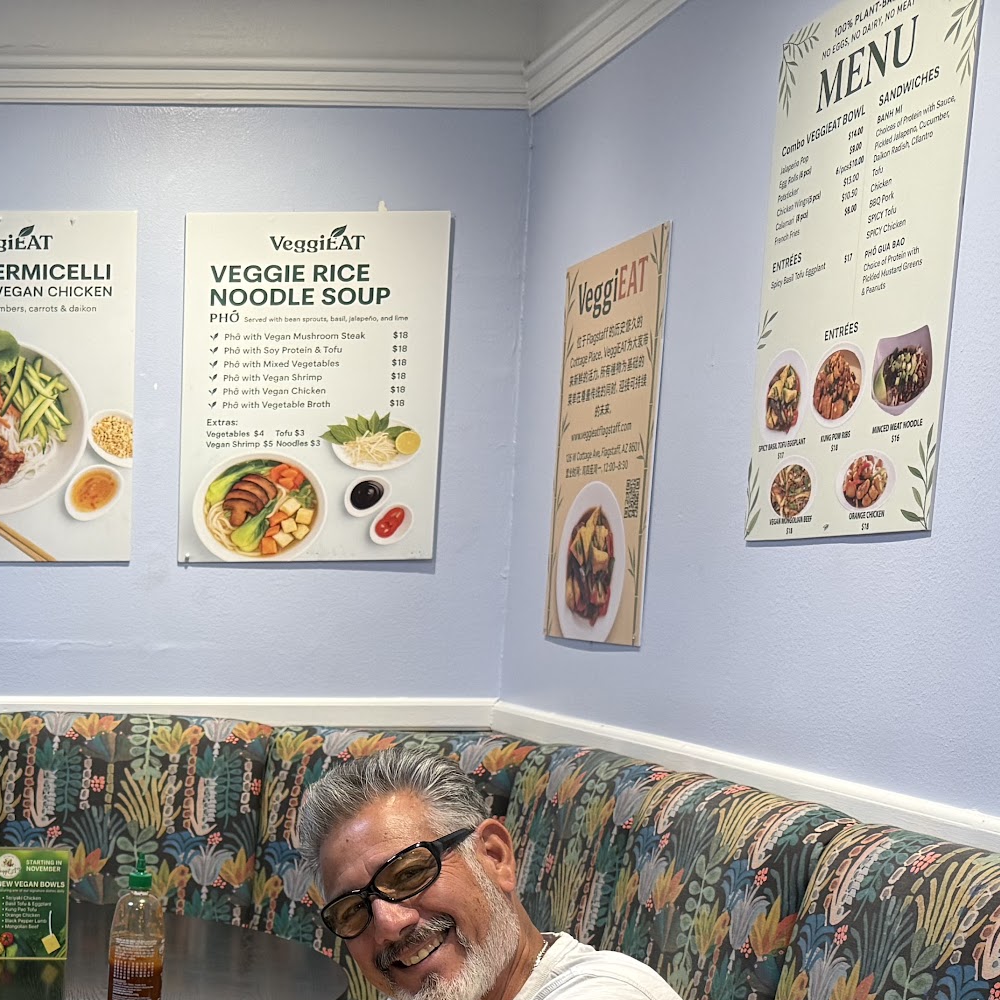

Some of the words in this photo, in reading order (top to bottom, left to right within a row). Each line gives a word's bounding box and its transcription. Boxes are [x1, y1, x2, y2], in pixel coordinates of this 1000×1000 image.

[822, 48, 831, 60] NO
[833, 38, 849, 53] EGGS,
[851, 30, 860, 42] NO
[863, 16, 883, 36] DAIRY,
[885, 9, 895, 22] NO
[834, 16, 853, 38] 100%
[816, 14, 920, 114] MENU
[878, 66, 940, 106] SANDWICHES
[876, 123, 896, 137] Choices
[897, 116, 903, 127] of
[903, 110, 921, 124] Protein
[923, 103, 935, 114] with
[936, 95, 956, 109] Sauce,
[877, 110, 895, 124] BANH
[895, 105, 903, 115] MI
[782, 139, 805, 157] Combo
[807, 117, 841, 144] VEGGIEAT
[843, 105, 865, 125] BOWL
[875, 137, 892, 150] Pickled
[870, 178, 892, 193] Chicken
[869, 197, 881, 209] BBQ
[881, 191, 895, 203] Pork
[866, 226, 882, 239] SPICY
[883, 219, 906, 233] Chicken
[270, 234, 365, 253] VeggiEAT
[210, 265, 305, 283] VEGGIE
[313, 264, 370, 282] RICE
[48, 286, 112, 297] CHICKEN
[211, 288, 315, 306] NOODLE
[321, 287, 390, 305] SOUP
[578, 255, 649, 319] VeggiEAT
[28, 305, 58, 313] carrots
[60, 304, 67, 312] &
[243, 333, 262, 341] with
[264, 333, 291, 342] Vegan
[293, 332, 339, 340] Mushroom
[341, 331, 365, 340] Steak
[393, 331, 408, 339] $18
[824, 322, 859, 341] ENTRÉES
[243, 346, 261, 354] with
[264, 346, 280, 355] Soy
[282, 346, 312, 354] Protein
[314, 346, 321, 354] &
[323, 345, 342, 354] Tofu
[392, 345, 408, 353] $18
[207, 418, 238, 426] Extras:
[206, 430, 250, 439] Vegetables
[254, 430, 264, 438] $4
[275, 429, 293, 437] Tofu
[295, 429, 305, 437] $3
[206, 441, 230, 449] Vegan
[232, 440, 261, 449] Shrimp
[263, 440, 273, 448] $5
[310, 439, 321, 447] $3
